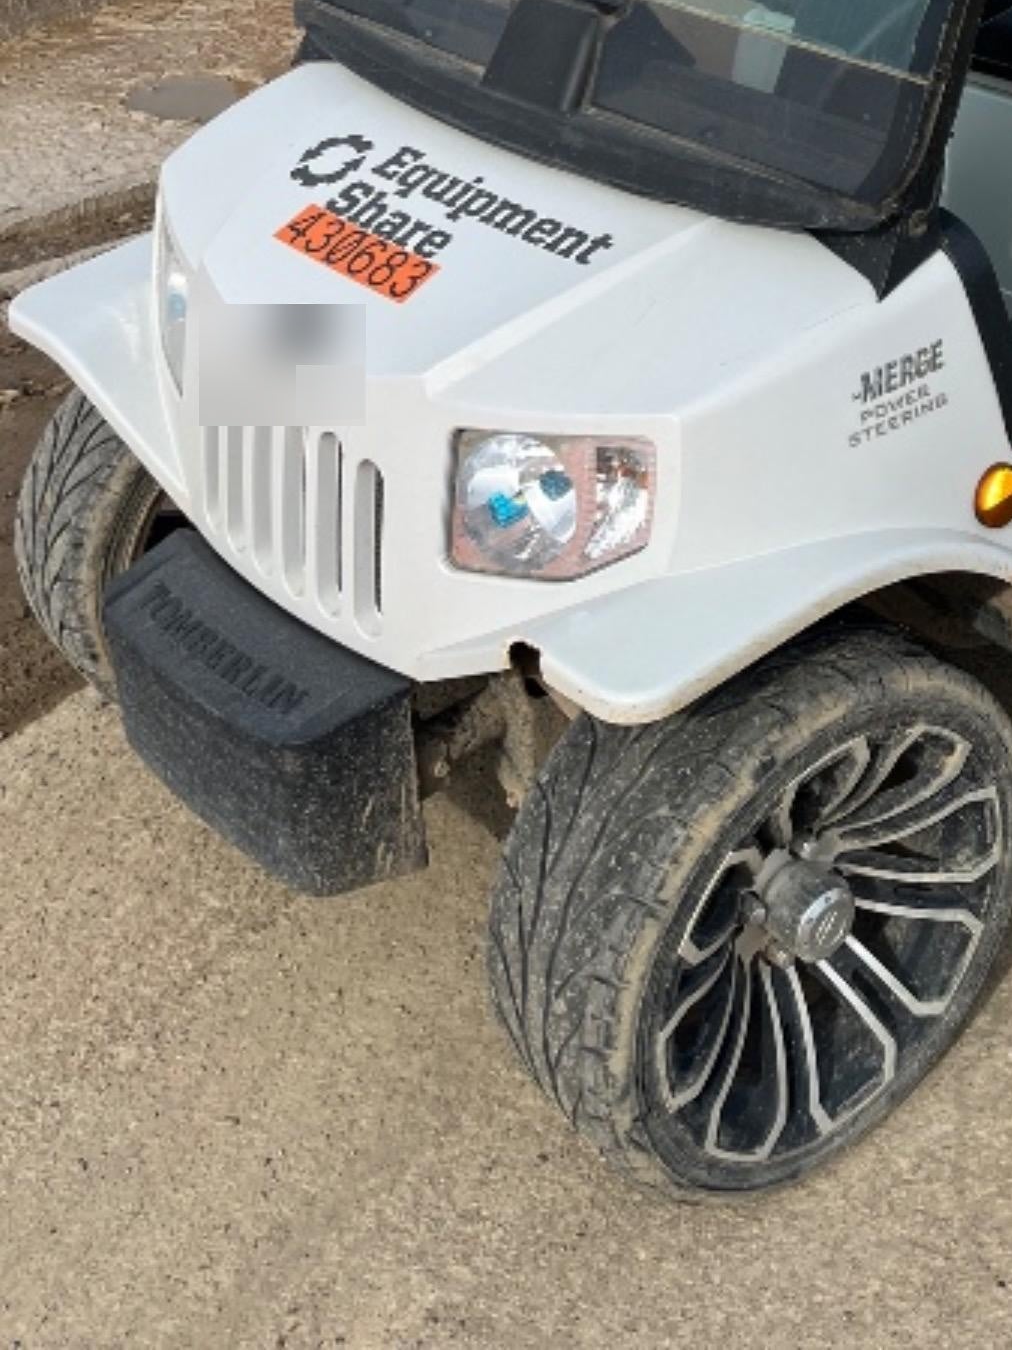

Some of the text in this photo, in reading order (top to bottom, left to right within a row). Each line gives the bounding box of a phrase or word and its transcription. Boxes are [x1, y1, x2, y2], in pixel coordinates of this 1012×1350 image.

[326, 181, 453, 258] Share
[372, 146, 615, 264] Equipment
[287, 211, 432, 298] 430683
[848, 392, 949, 448] STEERING
[860, 384, 931, 424] POWER
